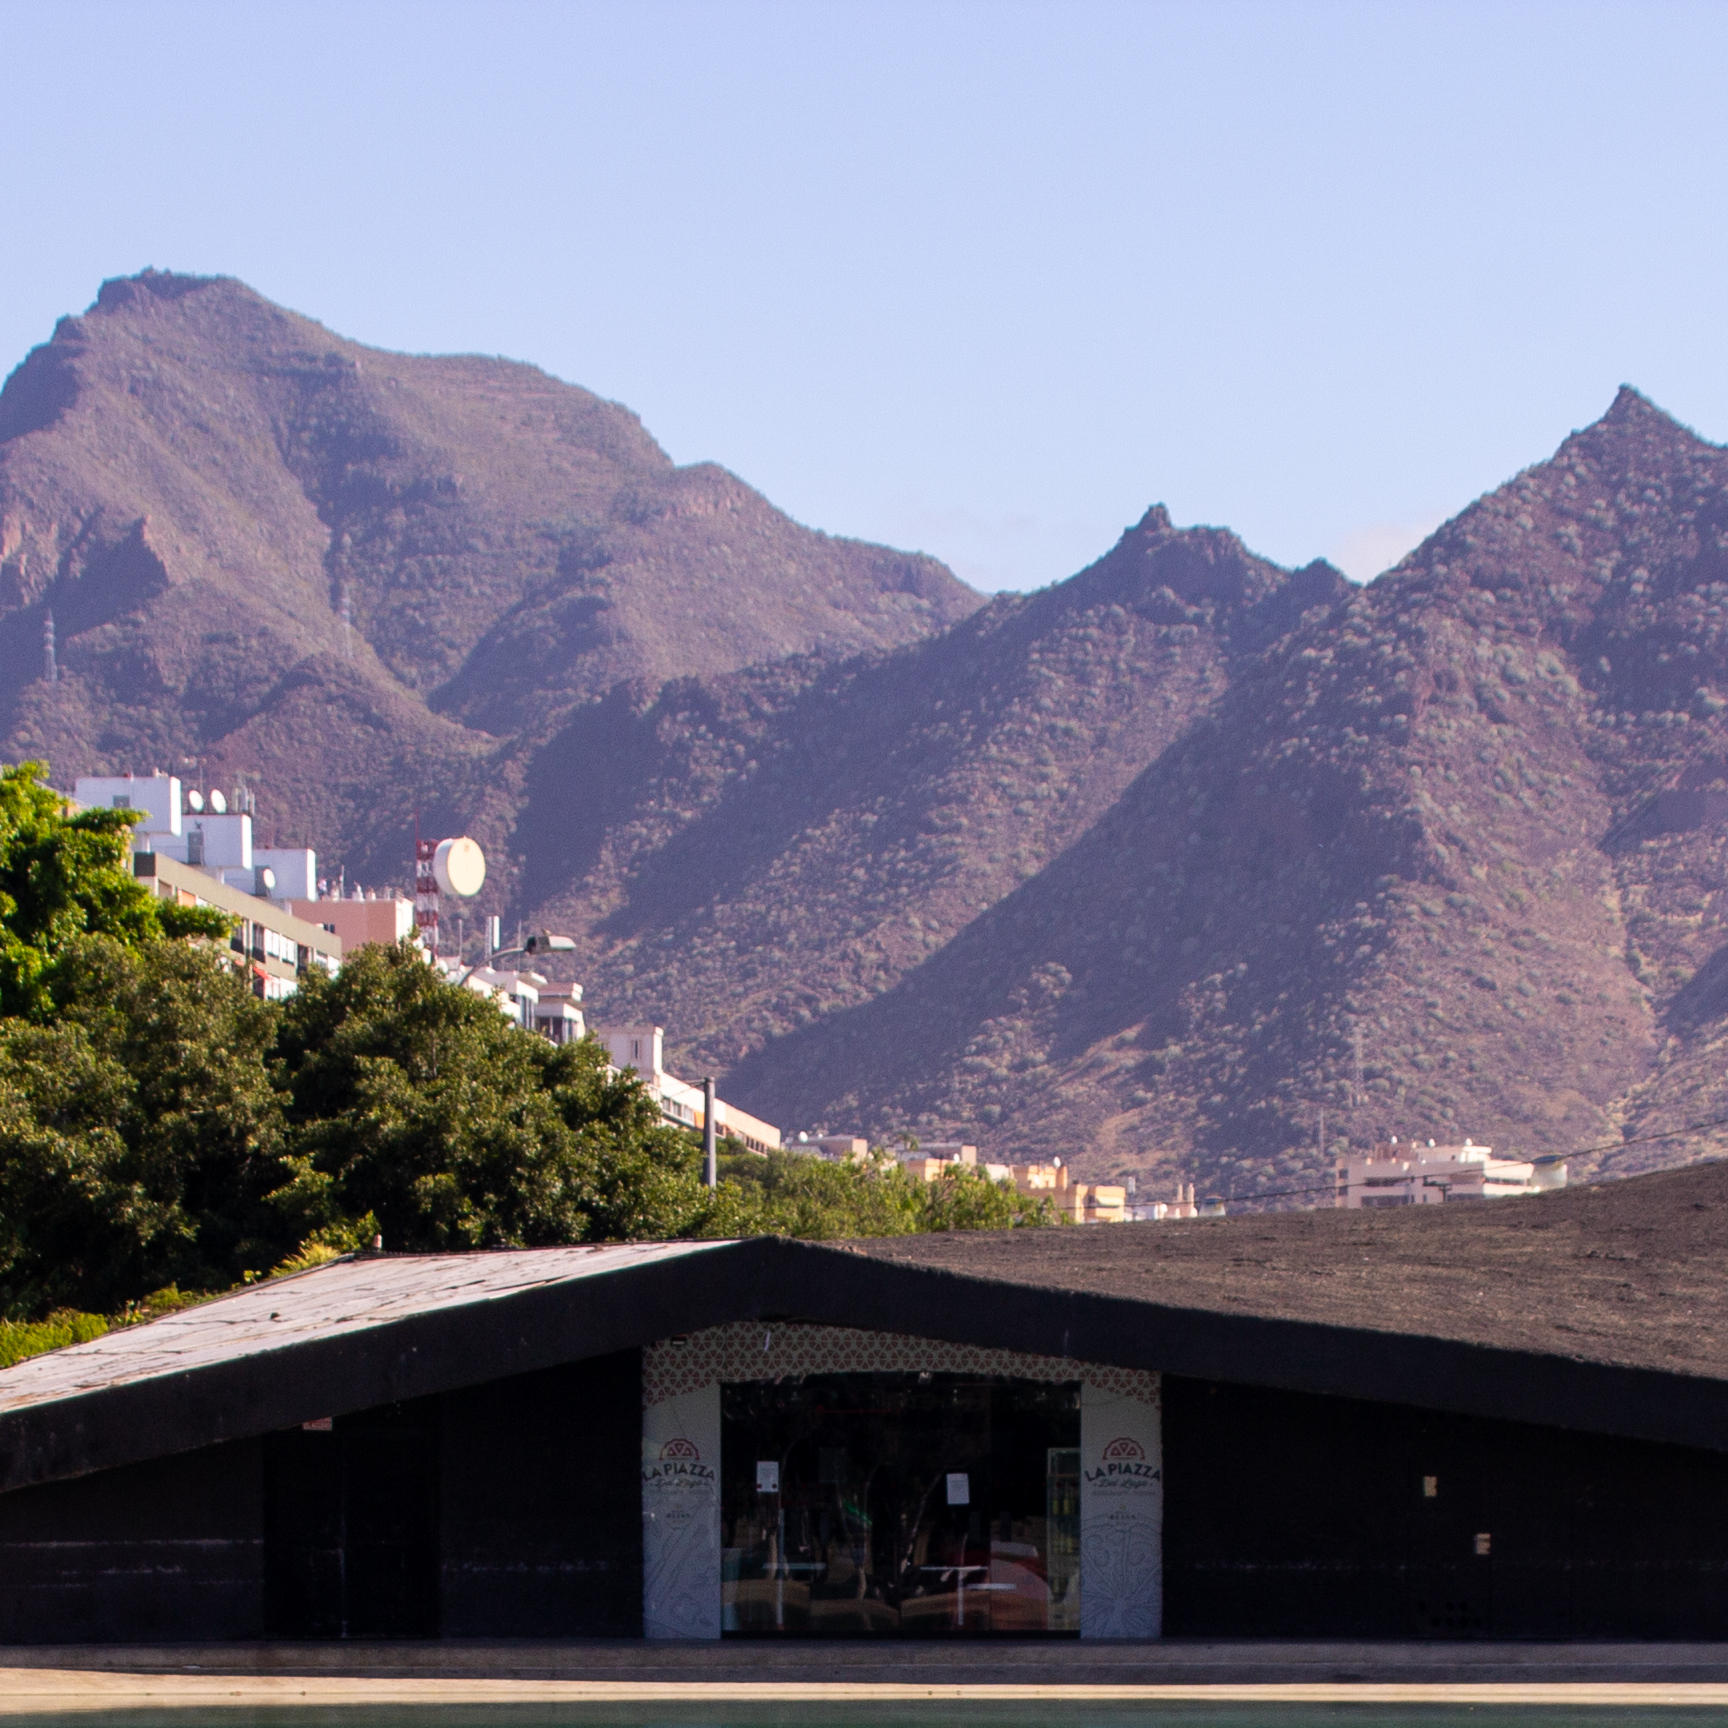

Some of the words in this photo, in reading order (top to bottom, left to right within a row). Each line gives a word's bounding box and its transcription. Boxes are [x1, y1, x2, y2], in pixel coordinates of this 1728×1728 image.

[642, 1467, 662, 1481] LA
[664, 1463, 714, 1480] PIAZZA
[1085, 1467, 1106, 1481] LA
[1108, 1463, 1160, 1481] PIAZZA
